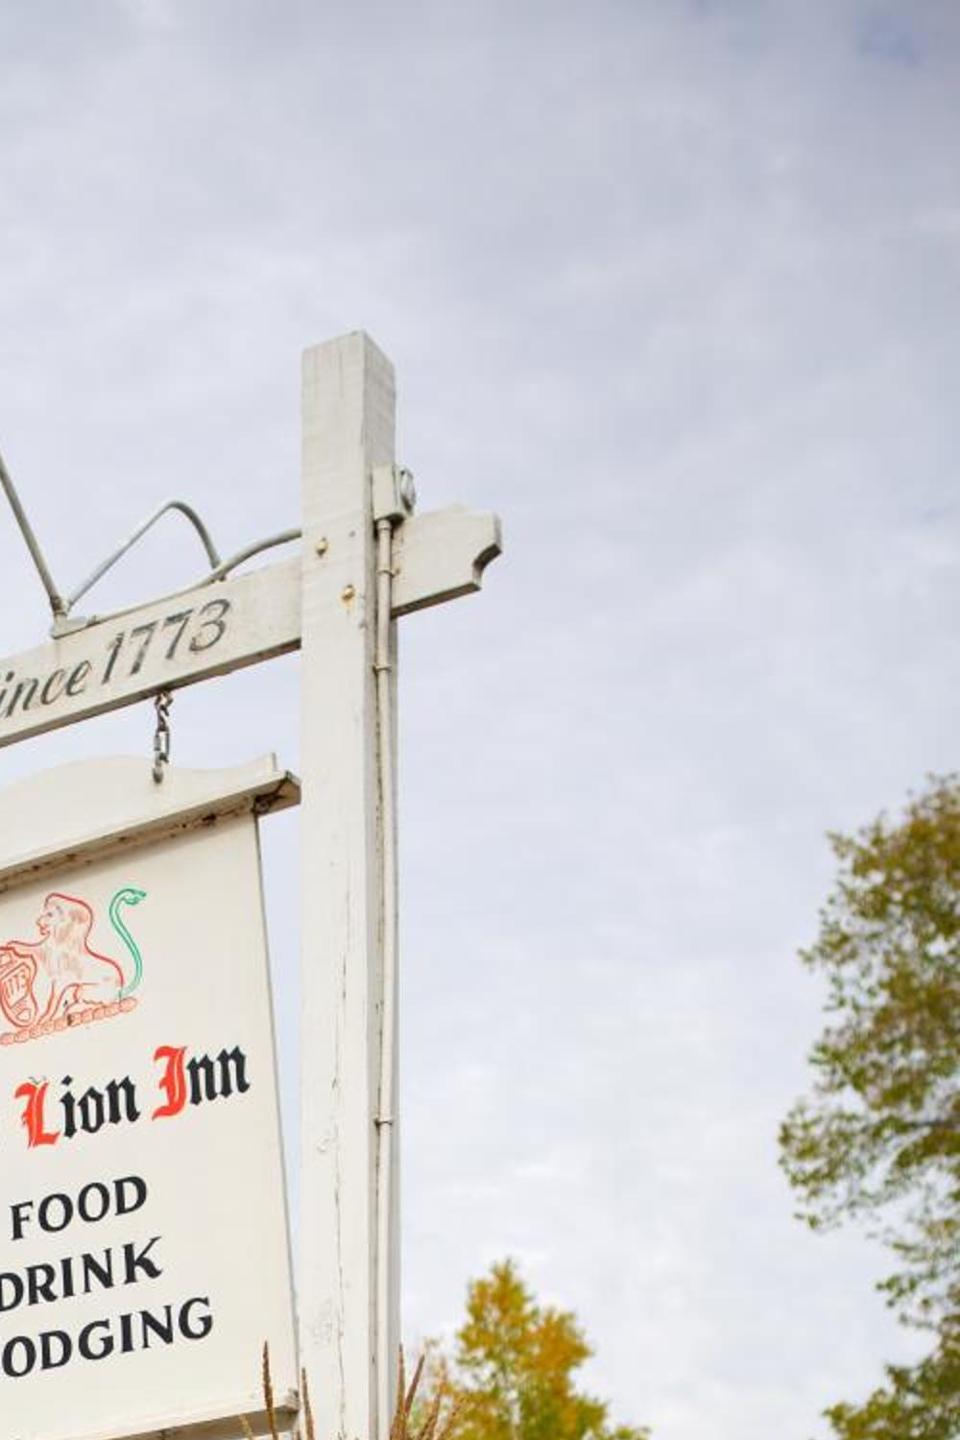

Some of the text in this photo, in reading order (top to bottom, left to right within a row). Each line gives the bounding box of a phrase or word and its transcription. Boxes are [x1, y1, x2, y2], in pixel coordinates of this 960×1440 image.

[103, 599, 231, 684] 1773
[14, 1075, 140, 1150] Lion
[151, 1045, 250, 1120] Inn
[9, 1175, 148, 1240] FOOD
